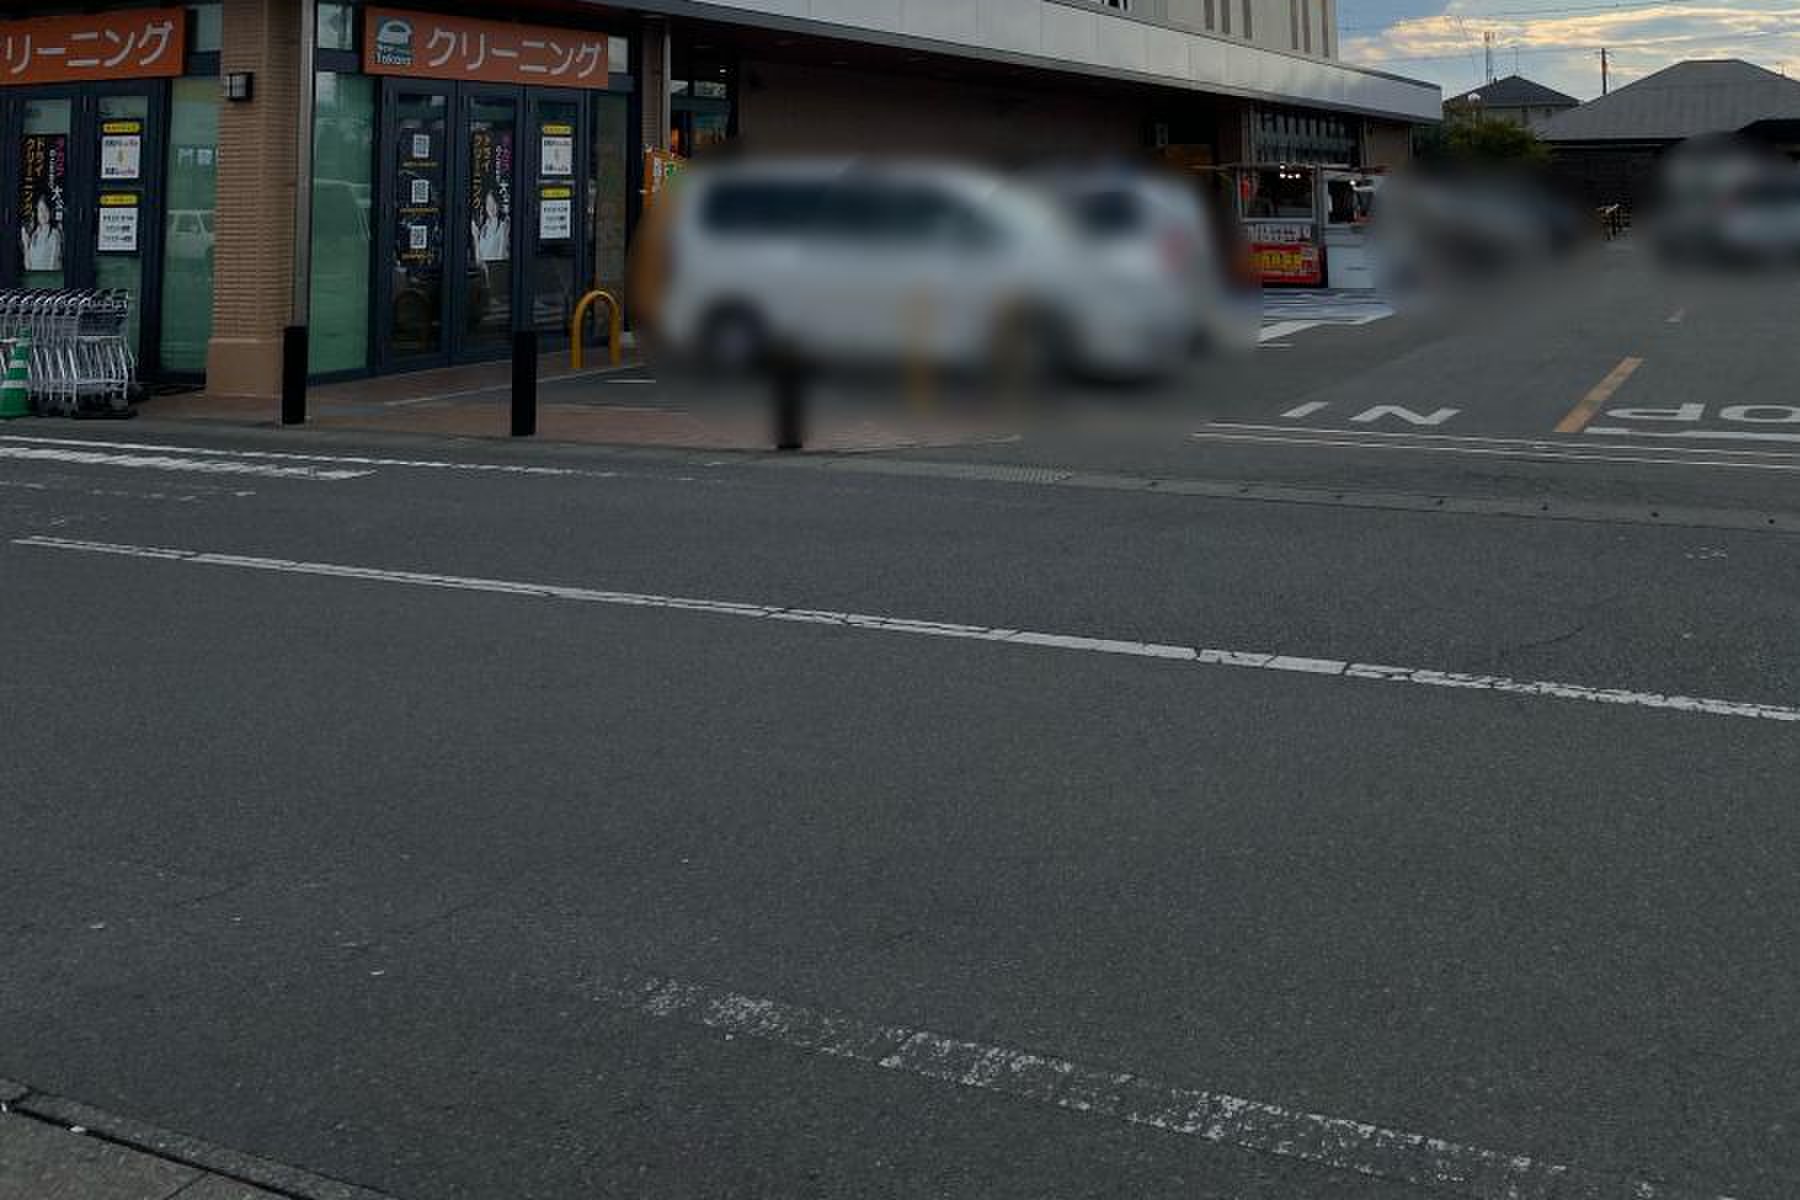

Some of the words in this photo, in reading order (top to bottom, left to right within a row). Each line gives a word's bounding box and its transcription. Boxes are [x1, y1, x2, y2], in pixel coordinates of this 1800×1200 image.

[426, 27, 603, 80] クリーニング
[1280, 401, 1461, 425] IN
